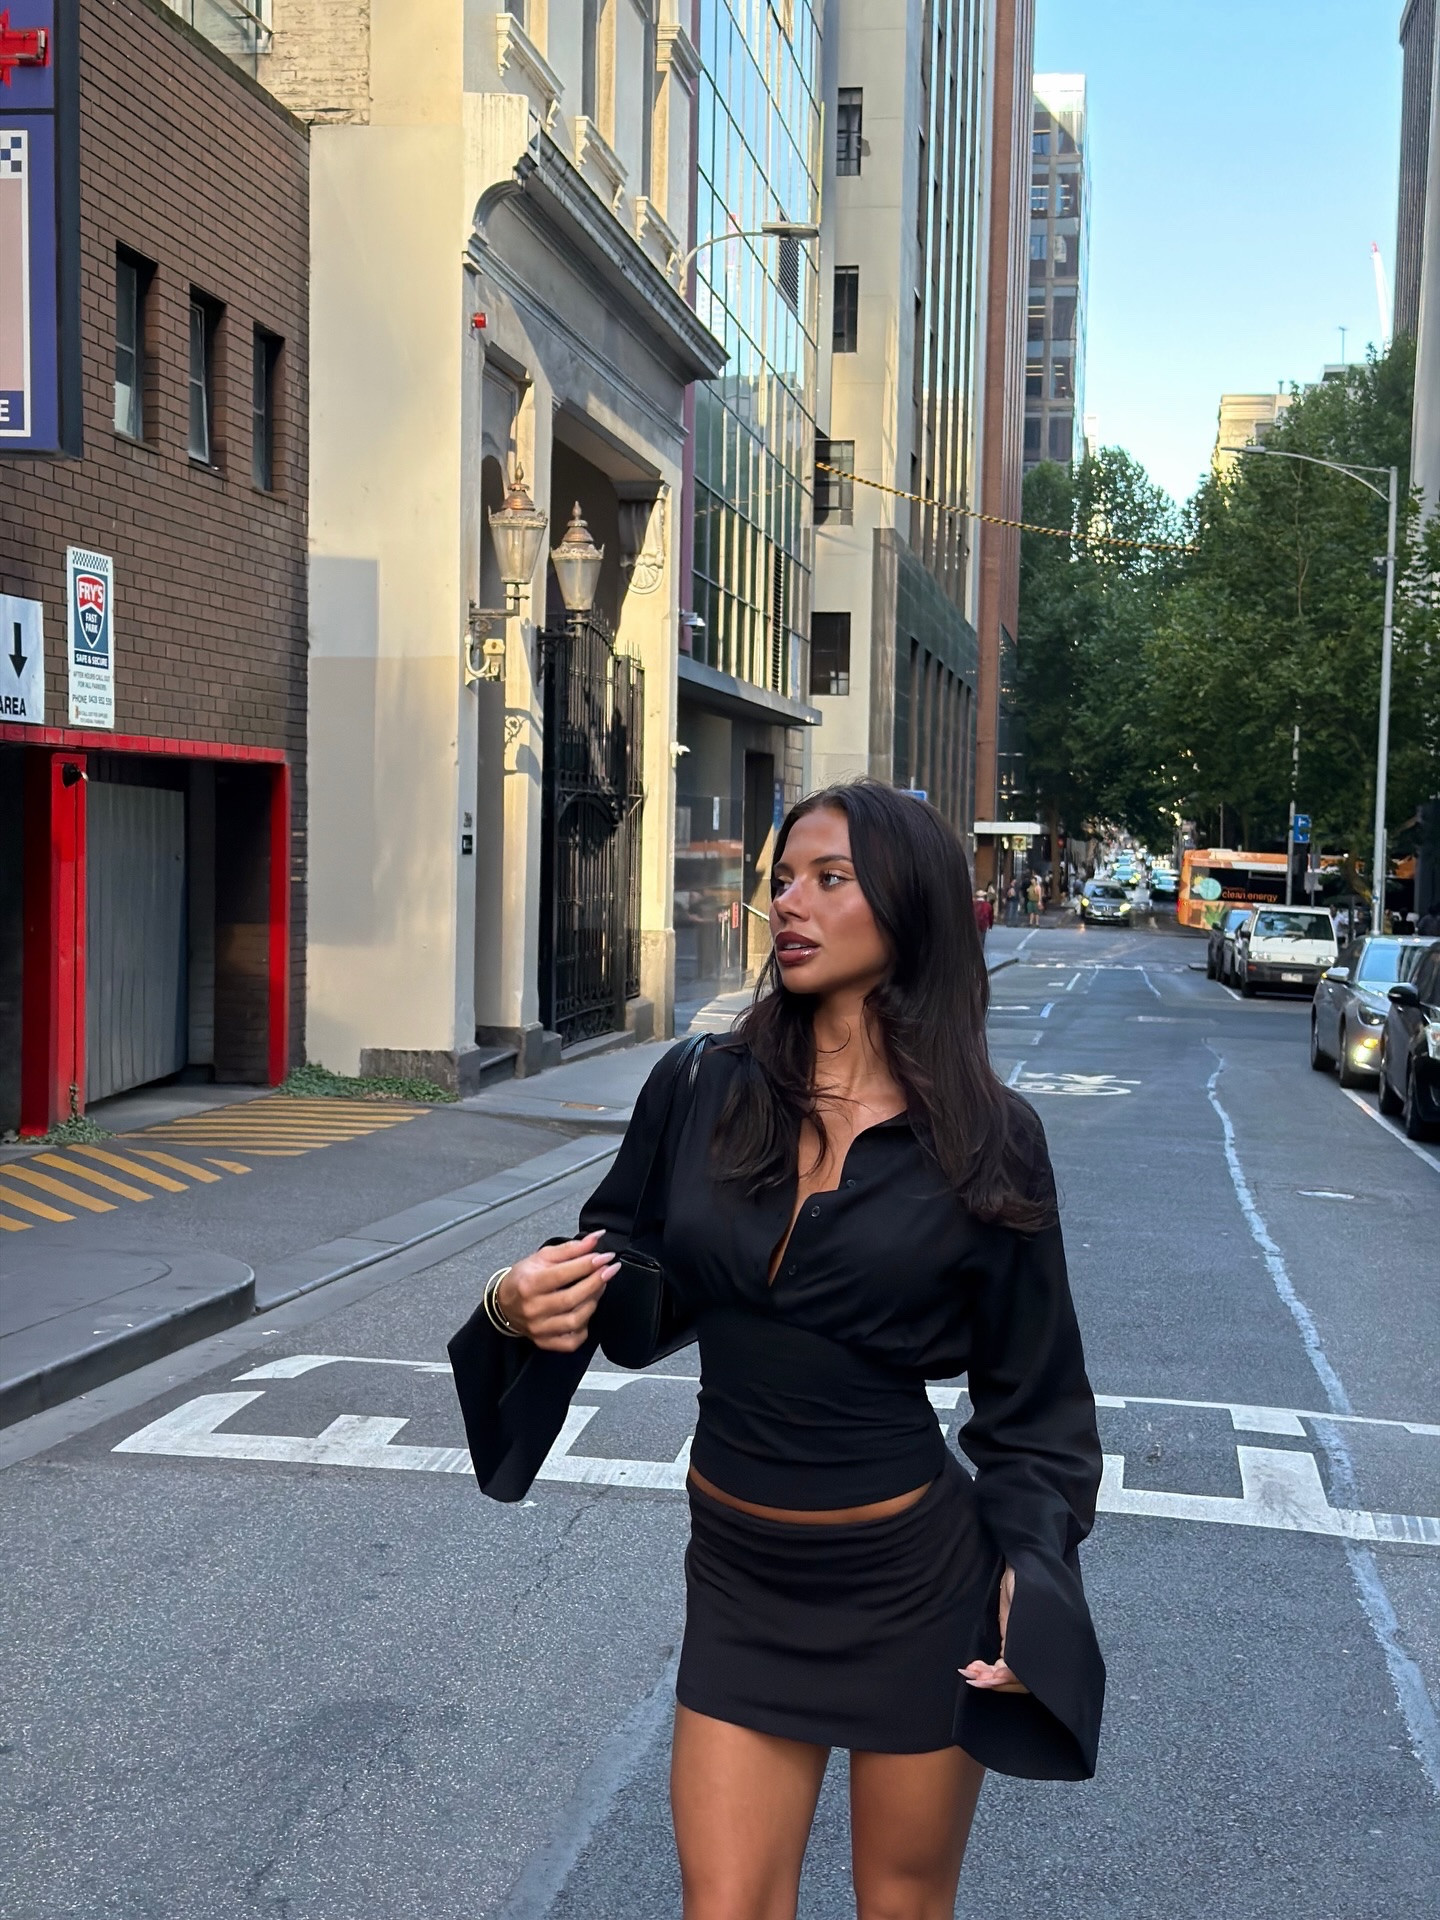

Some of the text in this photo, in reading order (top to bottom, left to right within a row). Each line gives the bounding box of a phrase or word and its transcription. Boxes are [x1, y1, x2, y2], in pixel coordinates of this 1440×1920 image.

[79, 581, 103, 604] FRY'S
[85, 612, 98, 623] FAST
[85, 622, 98, 634] PARK
[76, 653, 108, 667] SAFE & SECURE
[1222, 889, 1278, 902] clean energy
